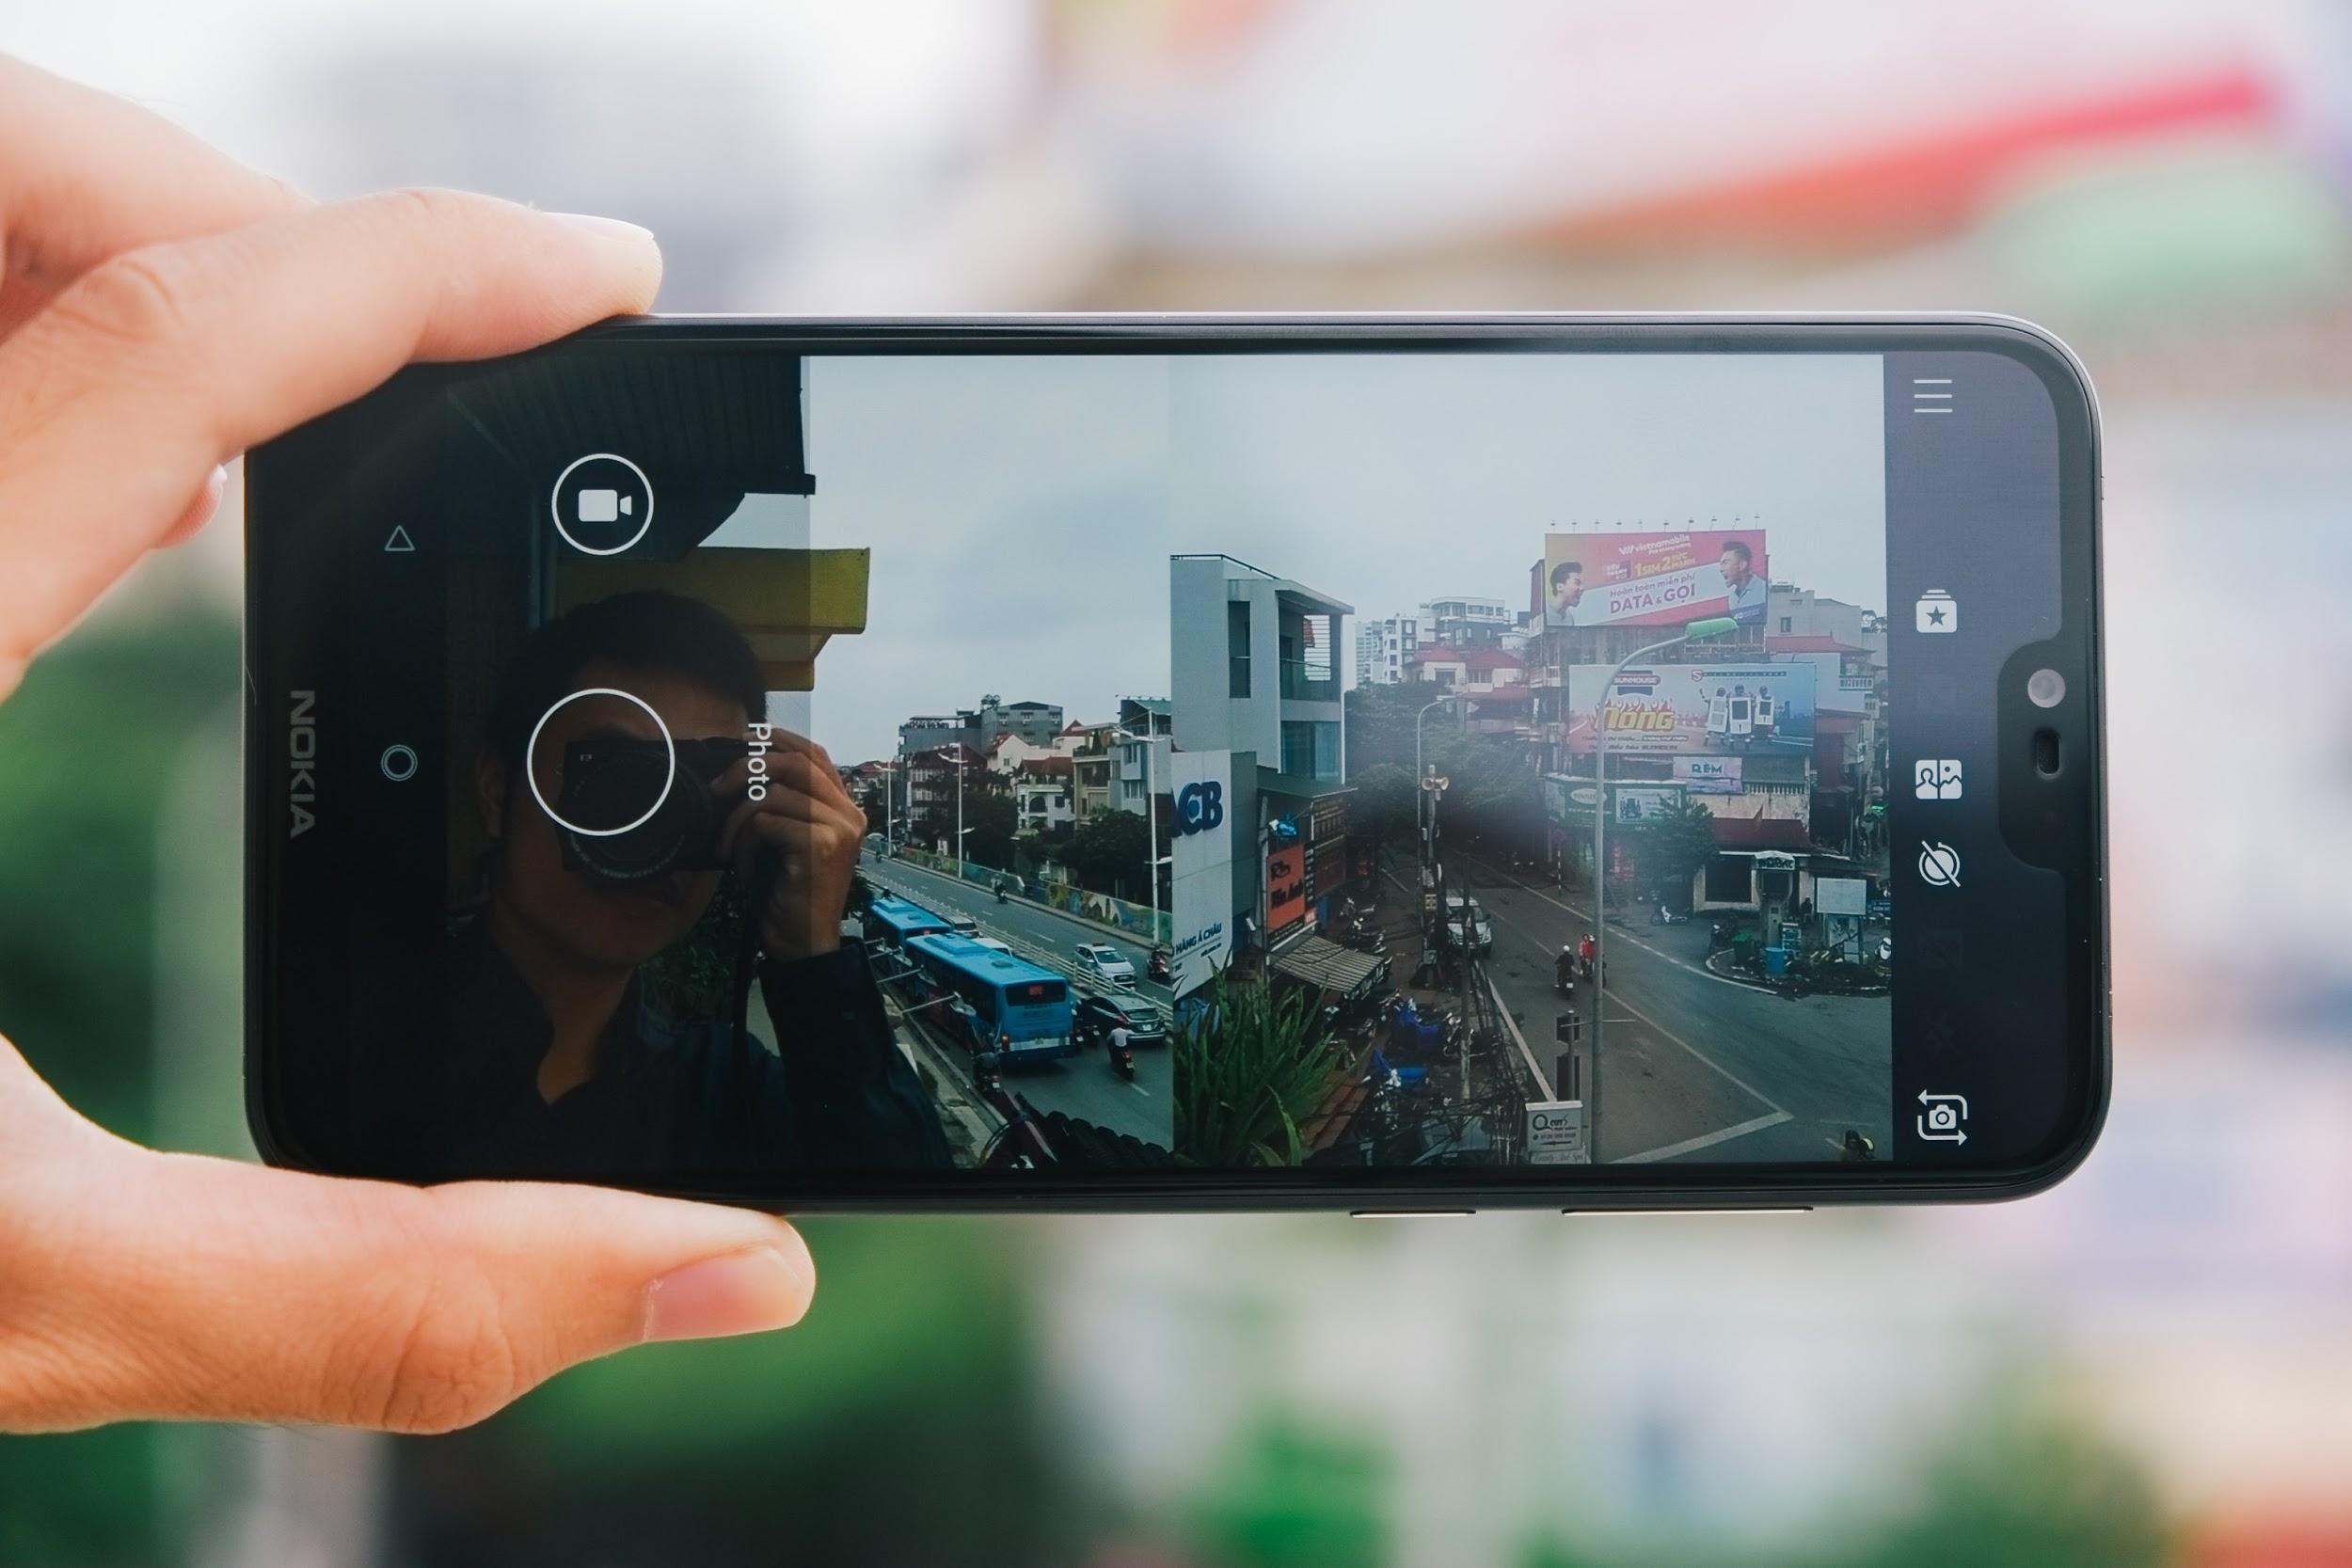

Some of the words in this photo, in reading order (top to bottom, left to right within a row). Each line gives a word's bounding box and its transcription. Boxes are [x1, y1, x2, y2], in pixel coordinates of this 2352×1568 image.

[1610, 593, 1654, 614] DATA
[1663, 583, 1695, 603] GỌI
[290, 690, 315, 839] NOKIA
[748, 723, 772, 801] Photo
[1171, 781, 1223, 837] CB
